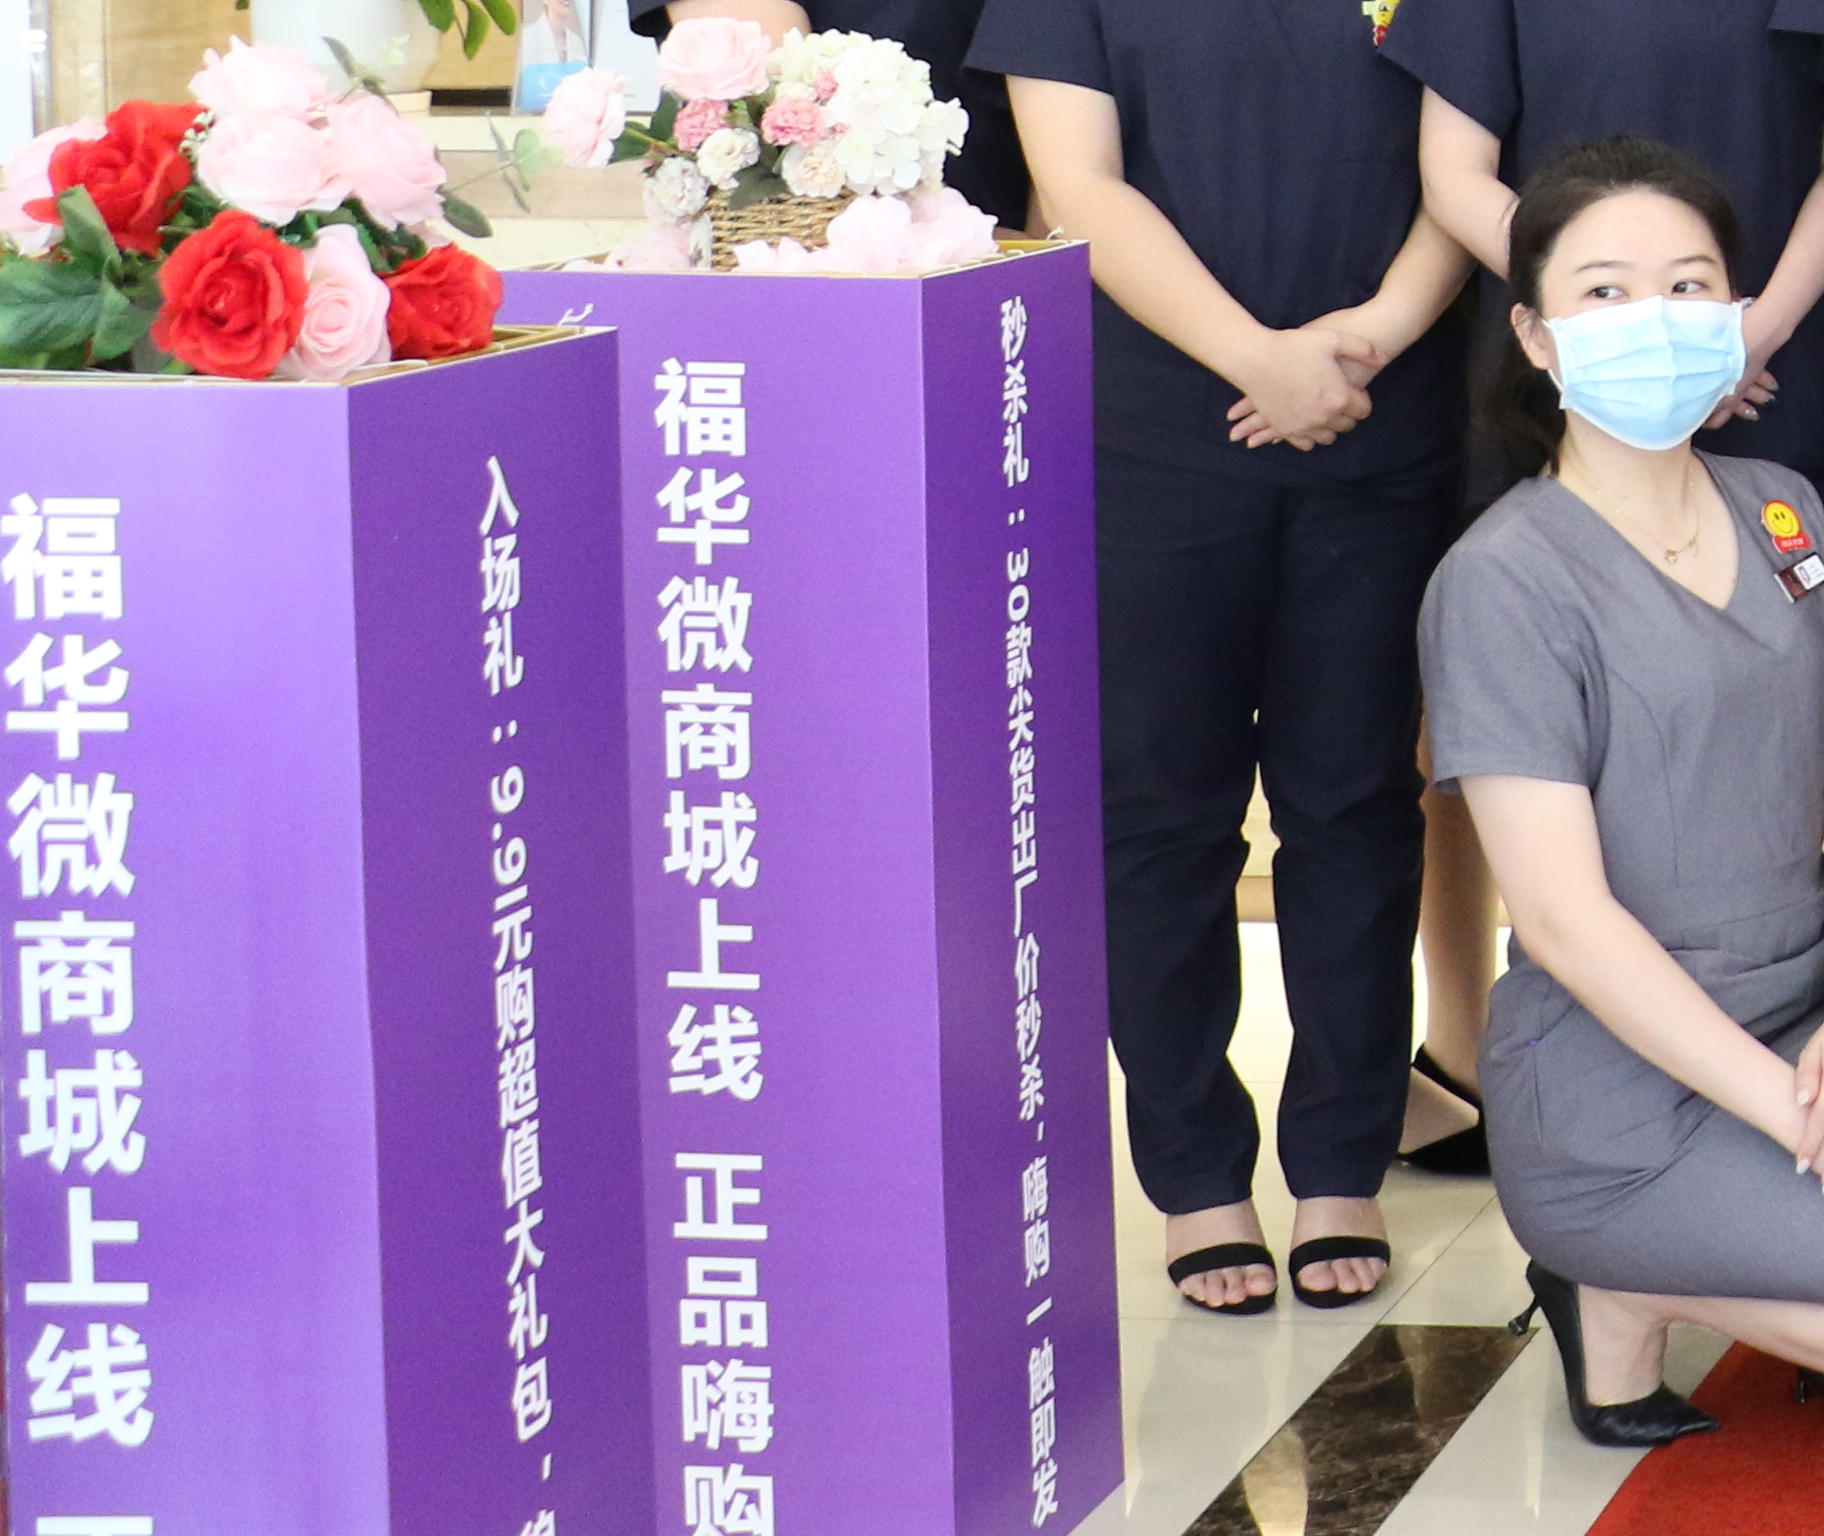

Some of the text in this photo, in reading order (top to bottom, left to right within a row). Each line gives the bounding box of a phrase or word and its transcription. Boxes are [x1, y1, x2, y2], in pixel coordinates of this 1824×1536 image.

[2, 493, 155, 1449] 福华微商城上线
[477, 456, 557, 1536] 入场礼：9.9元购超值大礼包，
[654, 358, 764, 1102] 福华微商城上线
